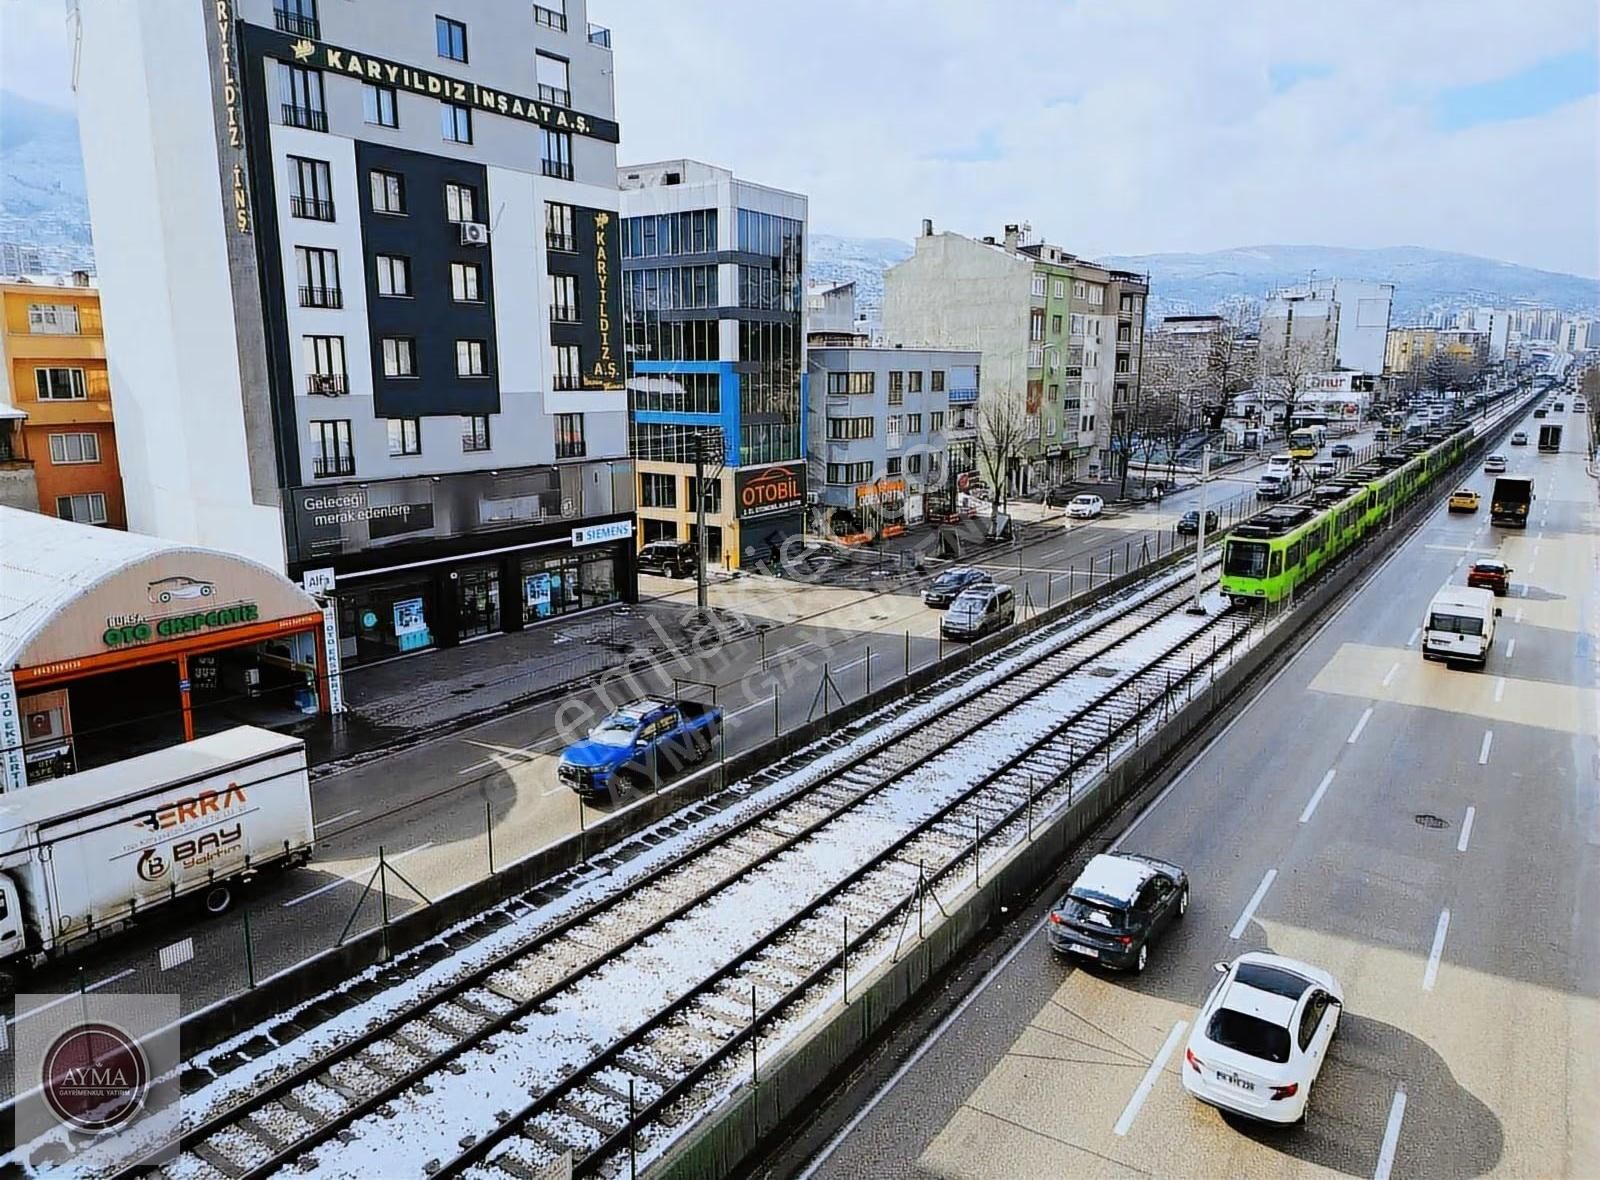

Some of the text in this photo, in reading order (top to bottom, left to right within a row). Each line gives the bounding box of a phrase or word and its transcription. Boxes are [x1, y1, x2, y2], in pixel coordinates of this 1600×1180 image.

[327, 48, 590, 134] KARYILDIZ İNŞAAT A.Ş.
[596, 231, 610, 360] KARYILDIZ
[314, 510, 357, 526] merak
[586, 524, 628, 541] SIEMENS
[103, 623, 151, 647] OTO
[0, 692, 13, 717] OTO
[173, 823, 242, 862] BAY
